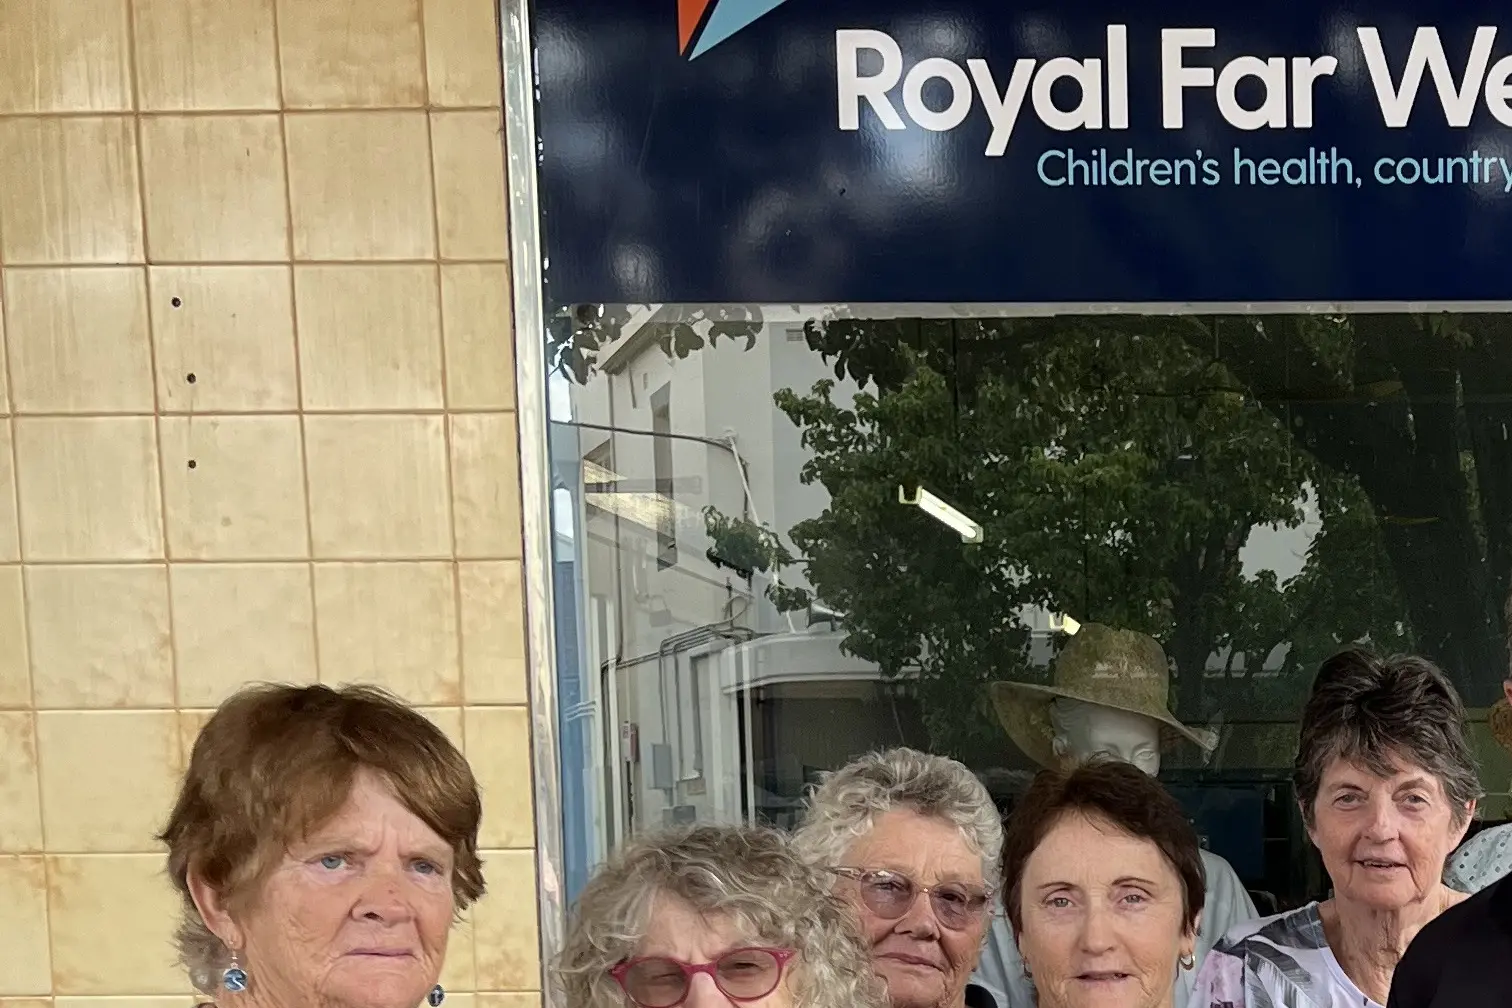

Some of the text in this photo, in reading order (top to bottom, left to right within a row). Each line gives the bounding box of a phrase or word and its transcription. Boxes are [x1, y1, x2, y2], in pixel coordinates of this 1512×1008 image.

[836, 24, 1129, 156] Royal
[1161, 26, 1338, 130] Far
[1037, 148, 1220, 188] Children's
[1232, 147, 1363, 190] health,
